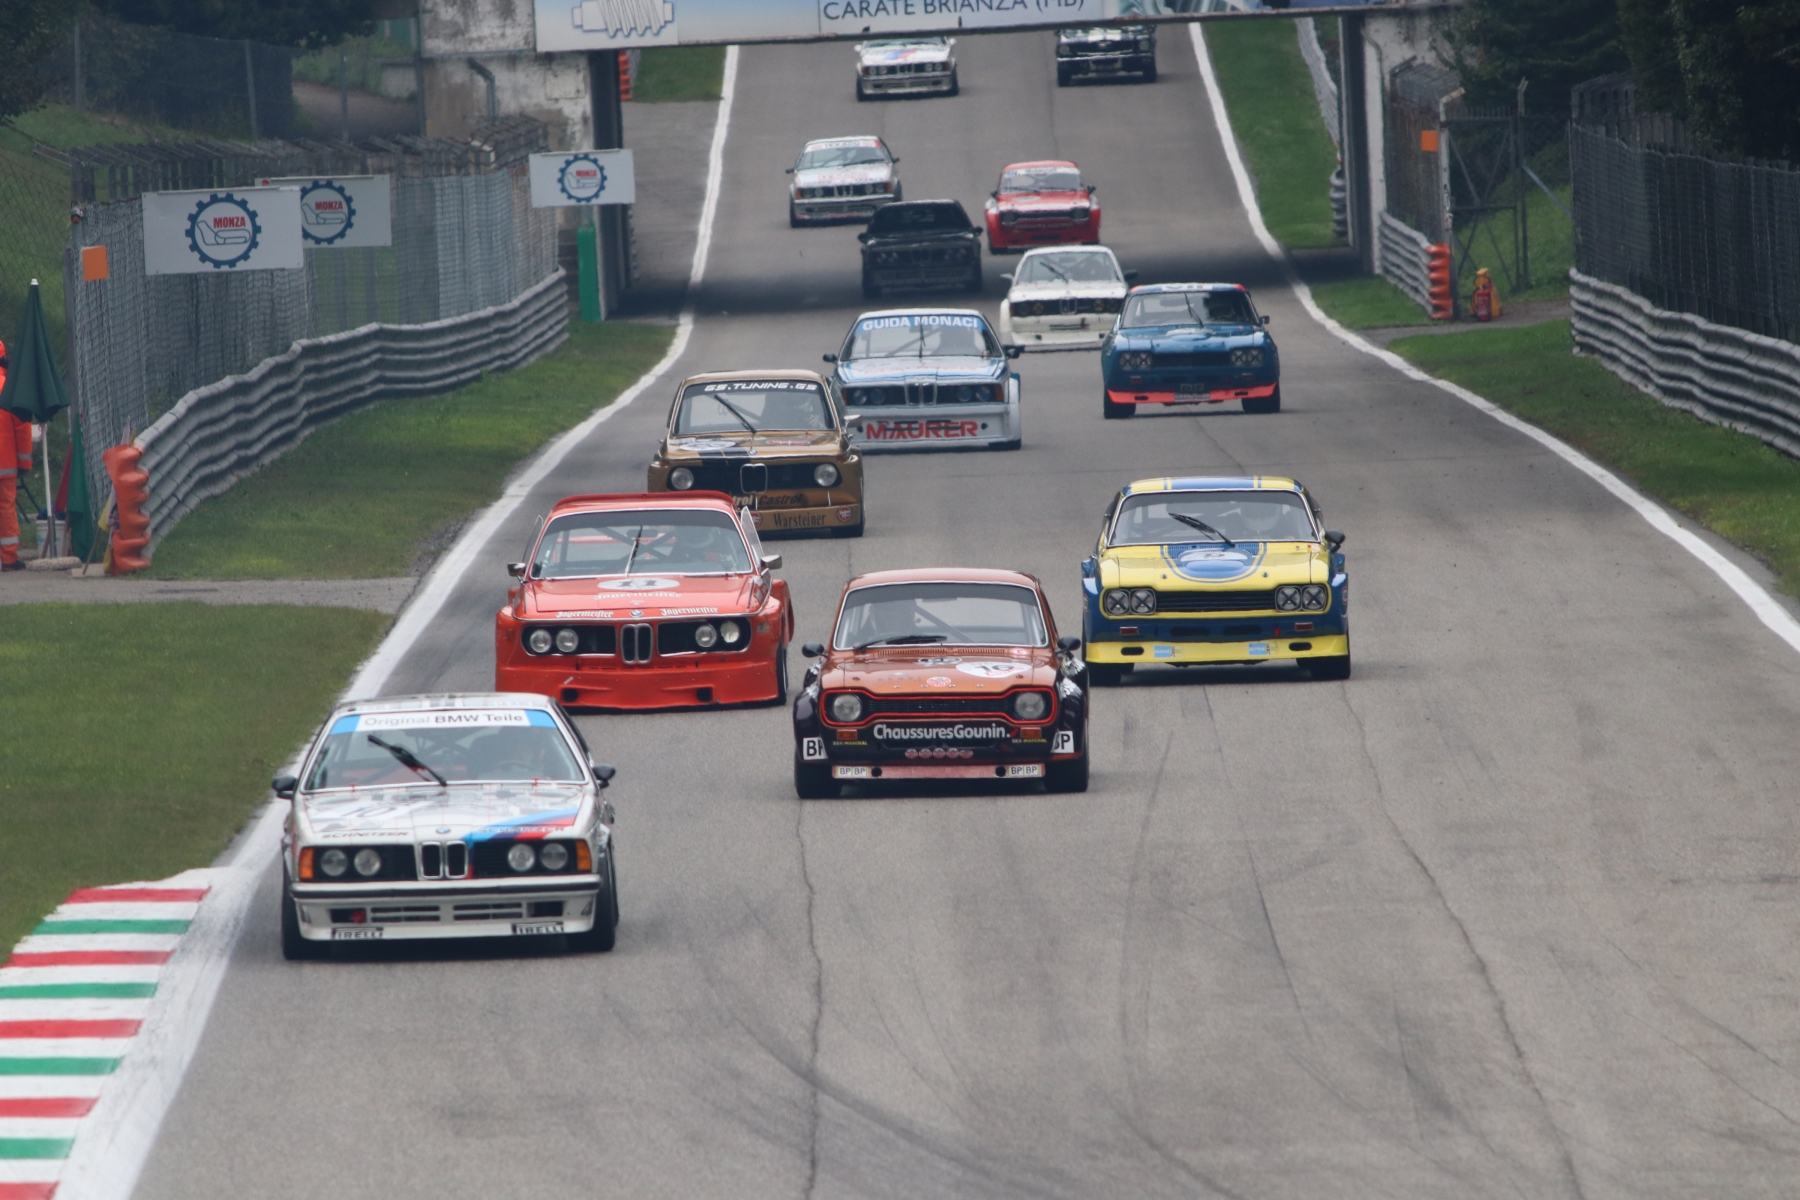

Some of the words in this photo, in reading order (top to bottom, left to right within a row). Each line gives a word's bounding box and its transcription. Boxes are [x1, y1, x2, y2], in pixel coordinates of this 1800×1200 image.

[823, 0, 916, 20] CARATE
[924, 0, 1029, 14] BRIANZA
[315, 201, 343, 211] MONZA
[213, 216, 246, 229] MONZA
[862, 317, 911, 331] GUIDA
[914, 315, 978, 328] MONACI
[866, 420, 979, 440] MAURER
[773, 511, 827, 528] Warsteiner
[364, 716, 430, 727] Original
[434, 714, 479, 724] BMW
[486, 713, 523, 722] Teile
[839, 767, 851, 775] BP
[854, 767, 866, 775] BP
[1011, 766, 1022, 775] BP
[1025, 765, 1037, 774] BP
